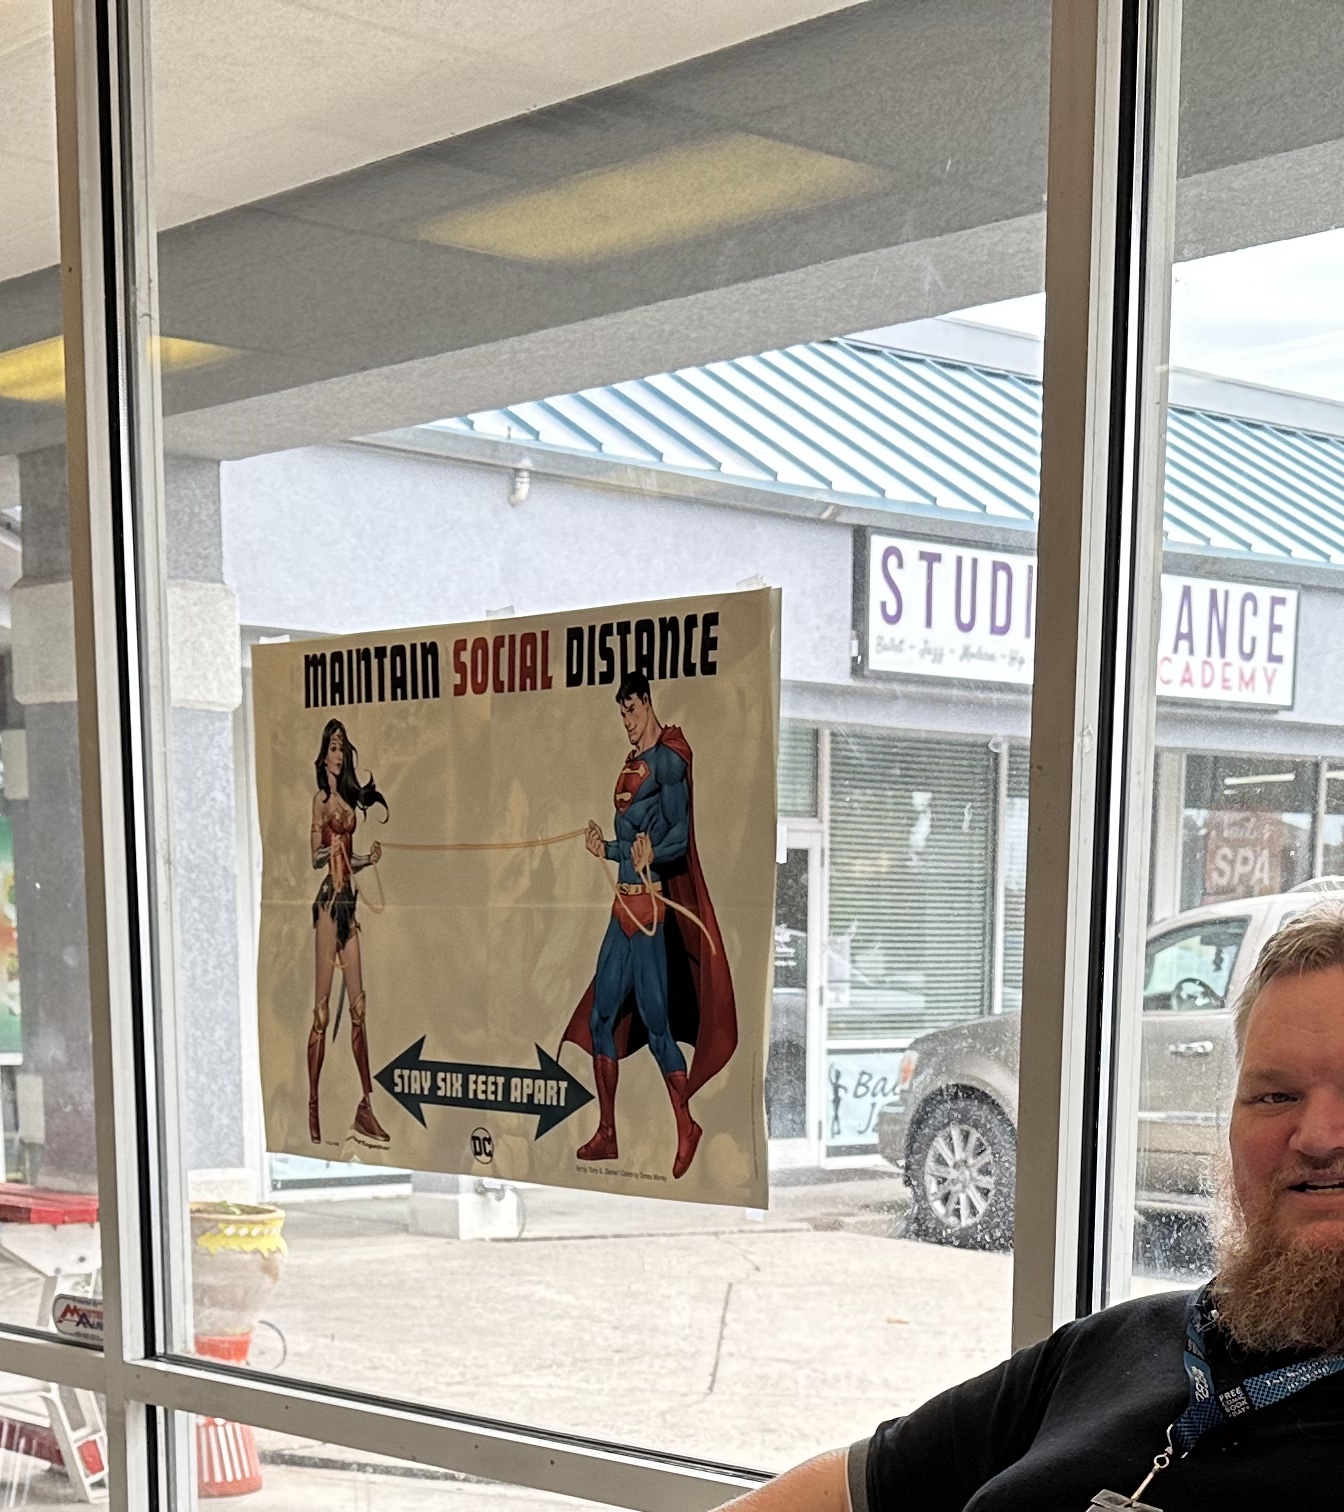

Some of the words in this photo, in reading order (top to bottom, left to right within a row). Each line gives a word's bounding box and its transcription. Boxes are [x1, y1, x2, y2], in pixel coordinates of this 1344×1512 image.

[304, 640, 440, 709] MAINTAIN
[453, 629, 553, 697] SOCIAL
[565, 612, 720, 688] DISTANCE
[1212, 847, 1270, 887] SPA
[393, 1067, 433, 1095] STAY
[437, 1071, 464, 1098] SIX
[468, 1073, 505, 1102] FEET
[510, 1076, 568, 1107] APART
[471, 1135, 493, 1158] DC
[1218, 1386, 1242, 1401] FREE
